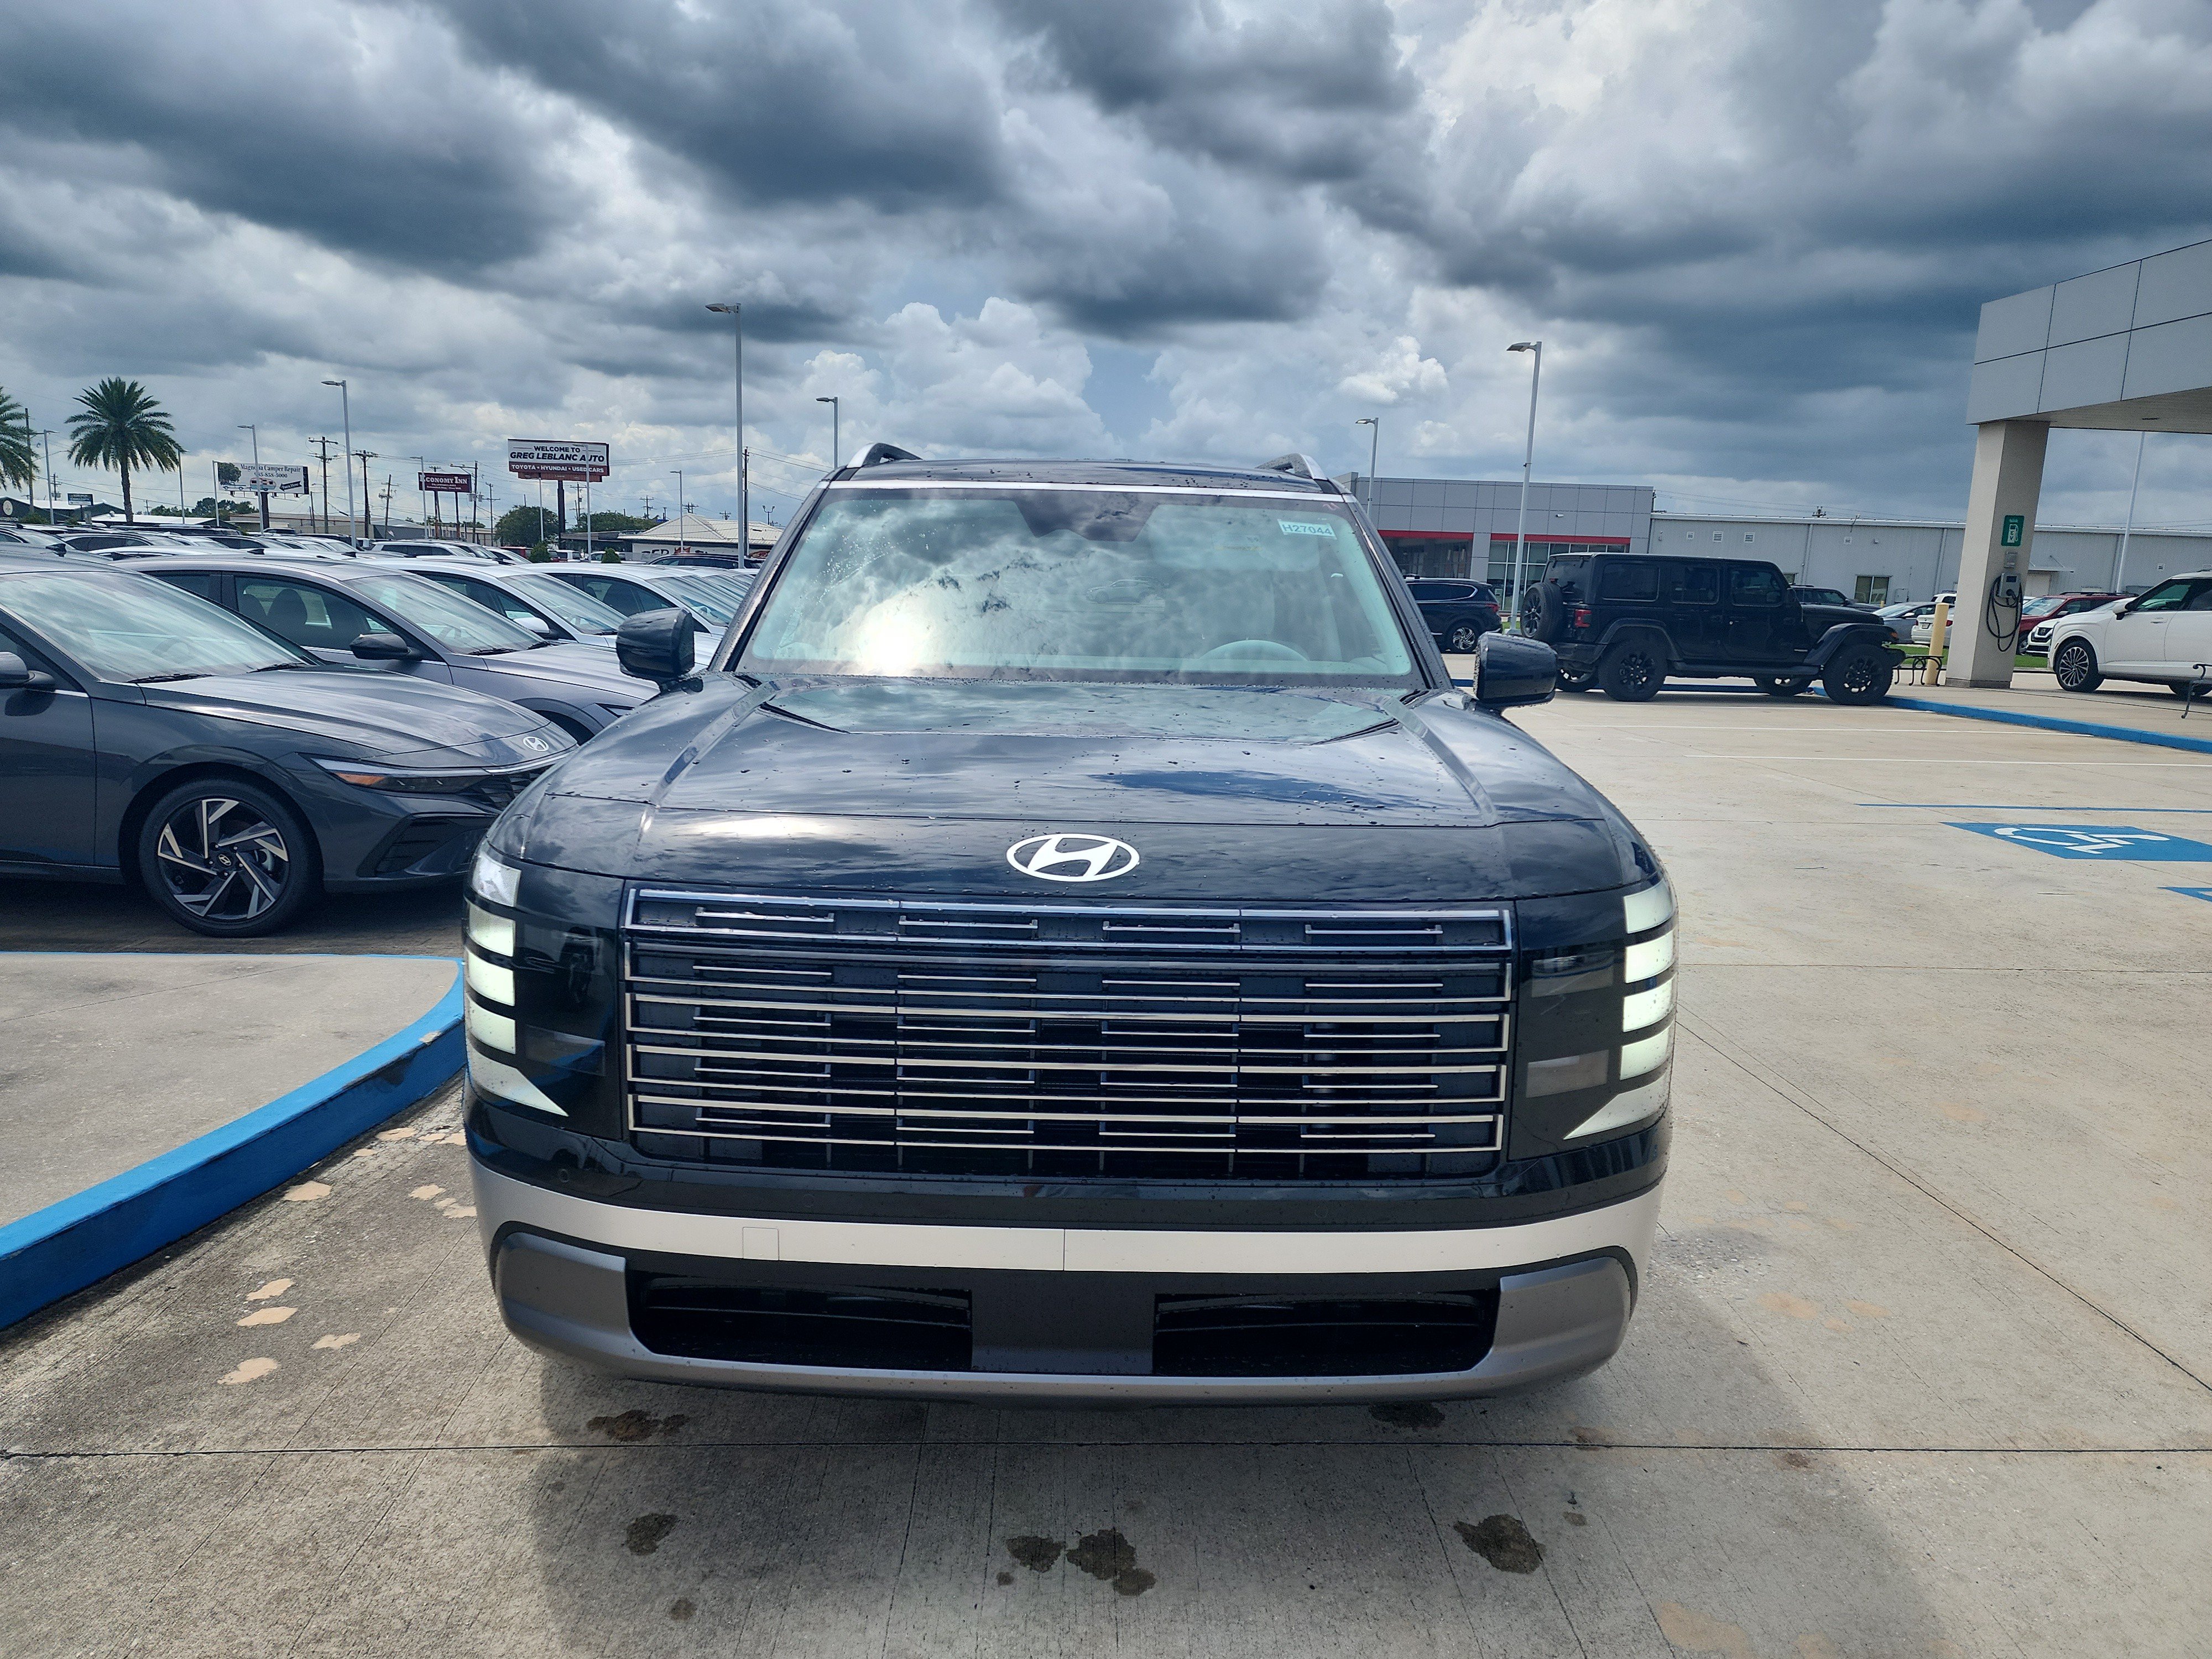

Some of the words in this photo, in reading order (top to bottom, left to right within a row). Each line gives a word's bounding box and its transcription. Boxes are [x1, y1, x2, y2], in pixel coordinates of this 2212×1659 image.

[536, 453, 578, 461] LEBLANC
[241, 463, 263, 472] Magnoia
[284, 466, 301, 474] Repair
[454, 476, 467, 484] INN
[1282, 524, 1332, 535] H27044
